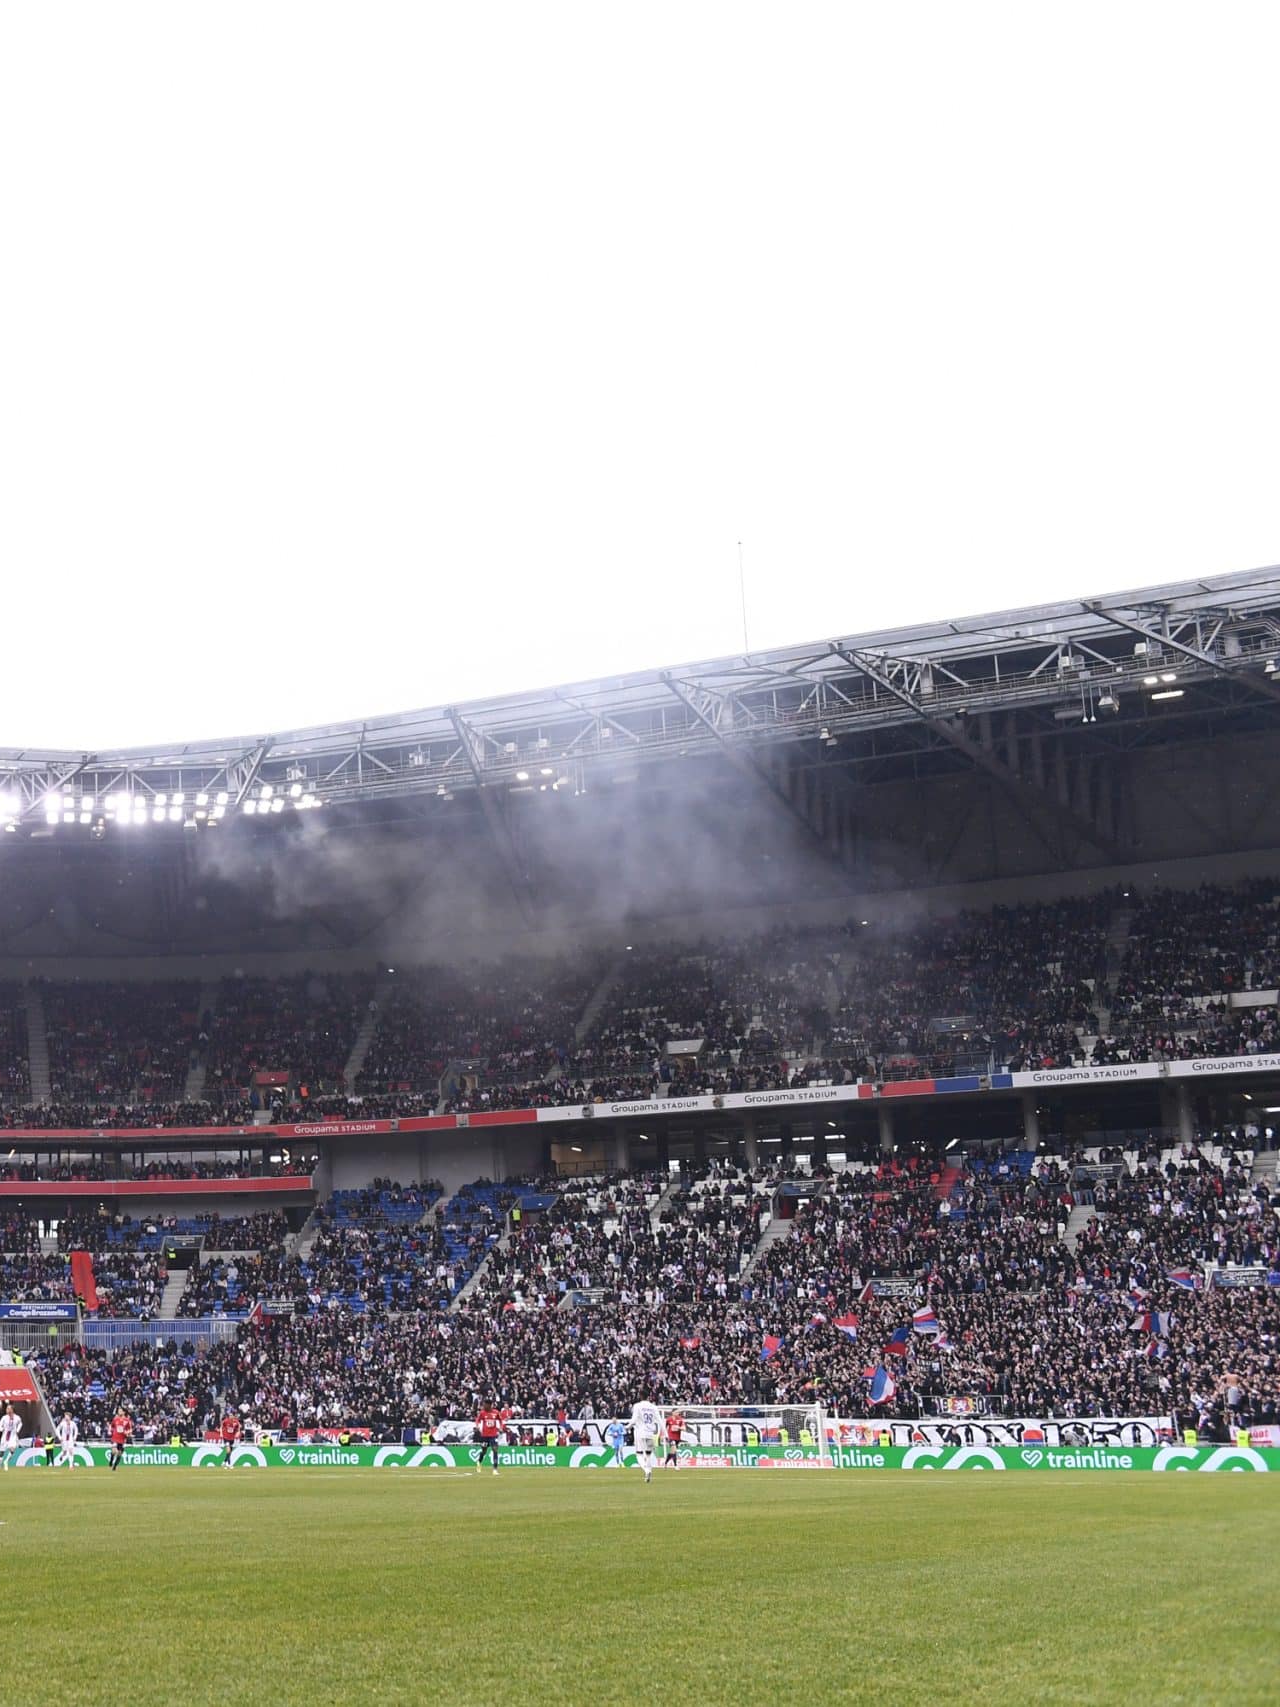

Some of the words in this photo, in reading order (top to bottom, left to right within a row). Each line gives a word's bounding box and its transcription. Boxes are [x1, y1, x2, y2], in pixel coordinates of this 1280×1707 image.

[1192, 1060, 1253, 1073] Groupama
[1032, 1072, 1090, 1084] Groupama
[1093, 1069, 1137, 1079] STADIUM
[744, 1093, 795, 1106] Groupama
[798, 1091, 837, 1101] STADIUM
[611, 1102, 659, 1115] Groupama
[661, 1100, 698, 1110] STADIUM
[294, 1125, 339, 1136] Groupama
[341, 1123, 376, 1133] STADIUM
[123, 1449, 179, 1465] trainline
[297, 1449, 360, 1465] trainline
[1047, 1451, 1133, 1469] trainline
